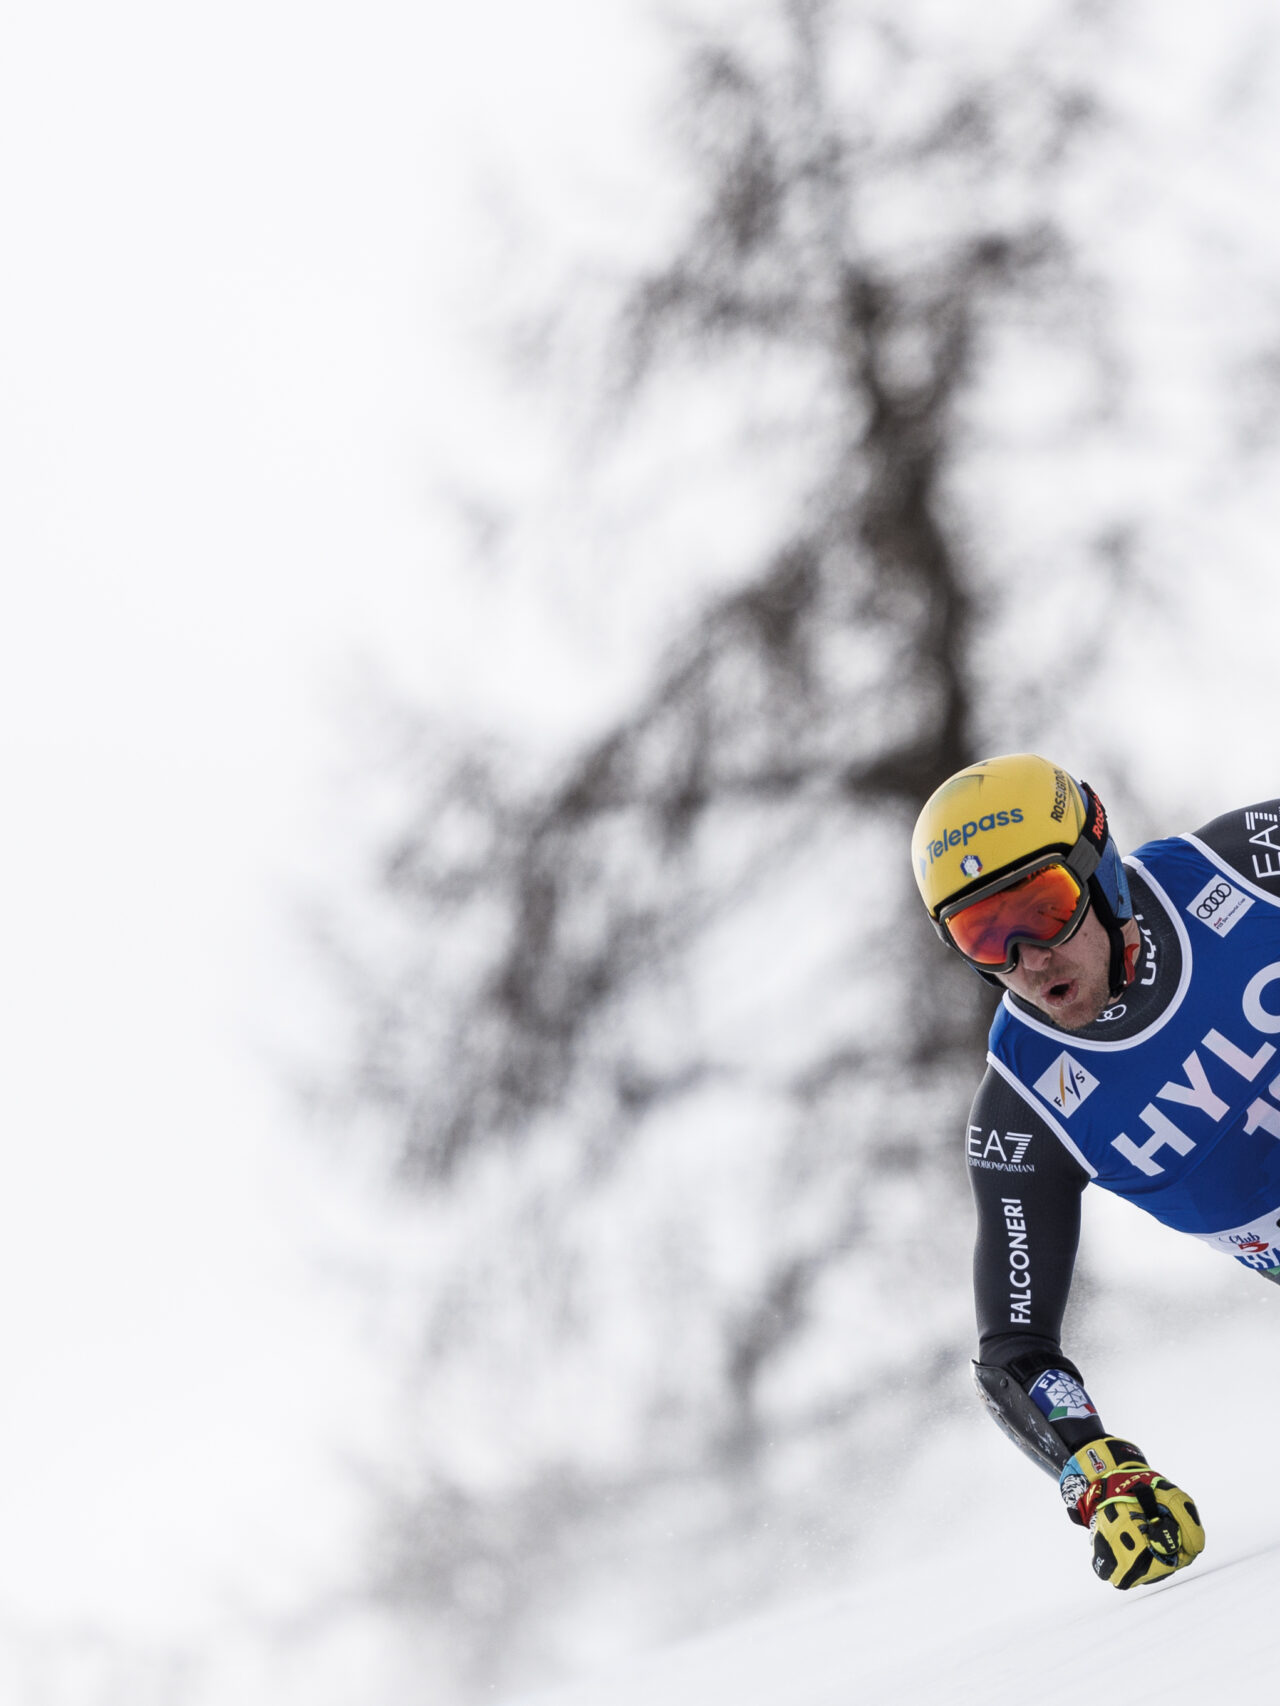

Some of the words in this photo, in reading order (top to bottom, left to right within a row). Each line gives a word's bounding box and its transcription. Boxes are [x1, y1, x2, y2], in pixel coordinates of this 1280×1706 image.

[926, 808, 1024, 864] Telepass
[968, 1125, 1033, 1163] EA7
[1001, 1197, 1031, 1324] FALCONERI
[1162, 1529, 1176, 1550] LEKI
